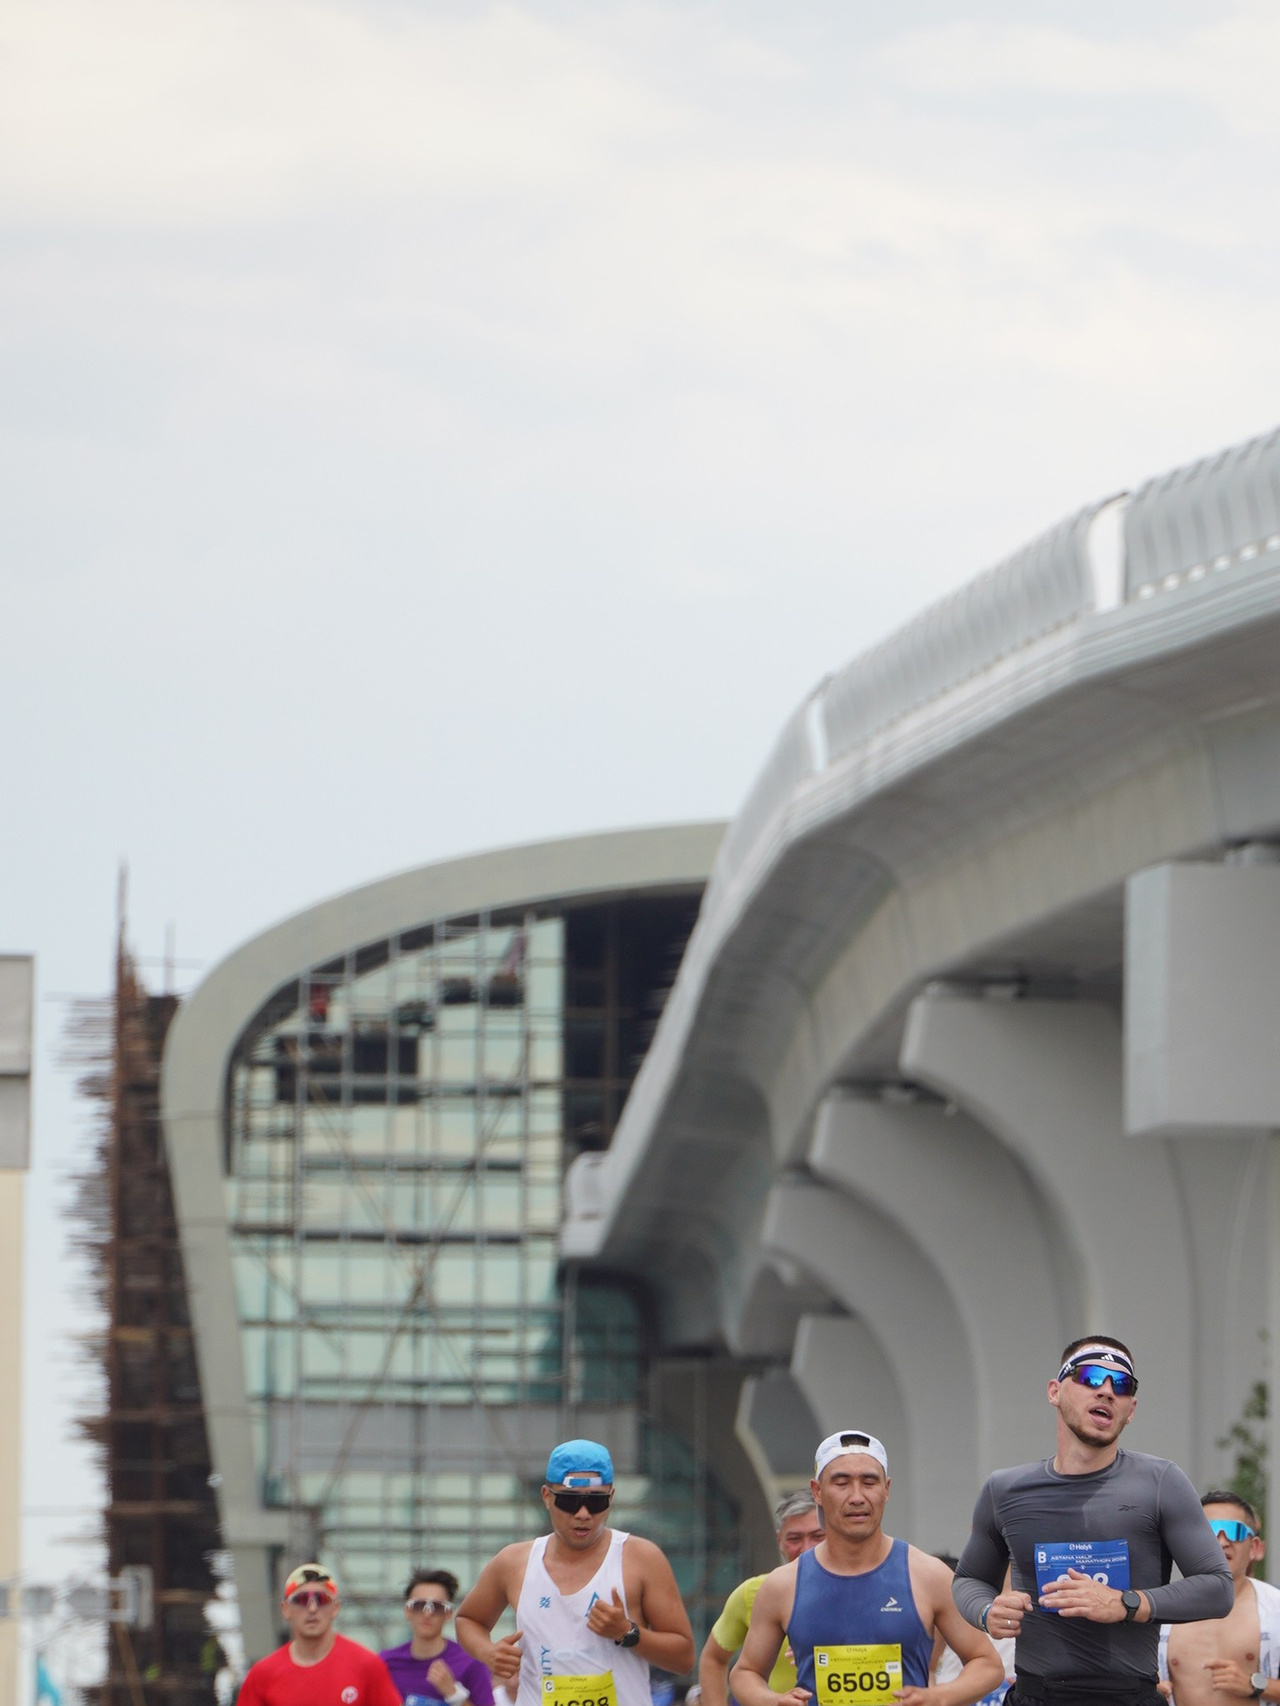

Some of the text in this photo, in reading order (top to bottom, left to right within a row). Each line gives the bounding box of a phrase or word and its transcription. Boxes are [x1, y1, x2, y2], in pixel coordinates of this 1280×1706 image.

[1037, 1551, 1047, 1564] B
[818, 1654, 827, 1665] E
[545, 1681, 553, 1691] C
[827, 1671, 891, 1693] 6509
